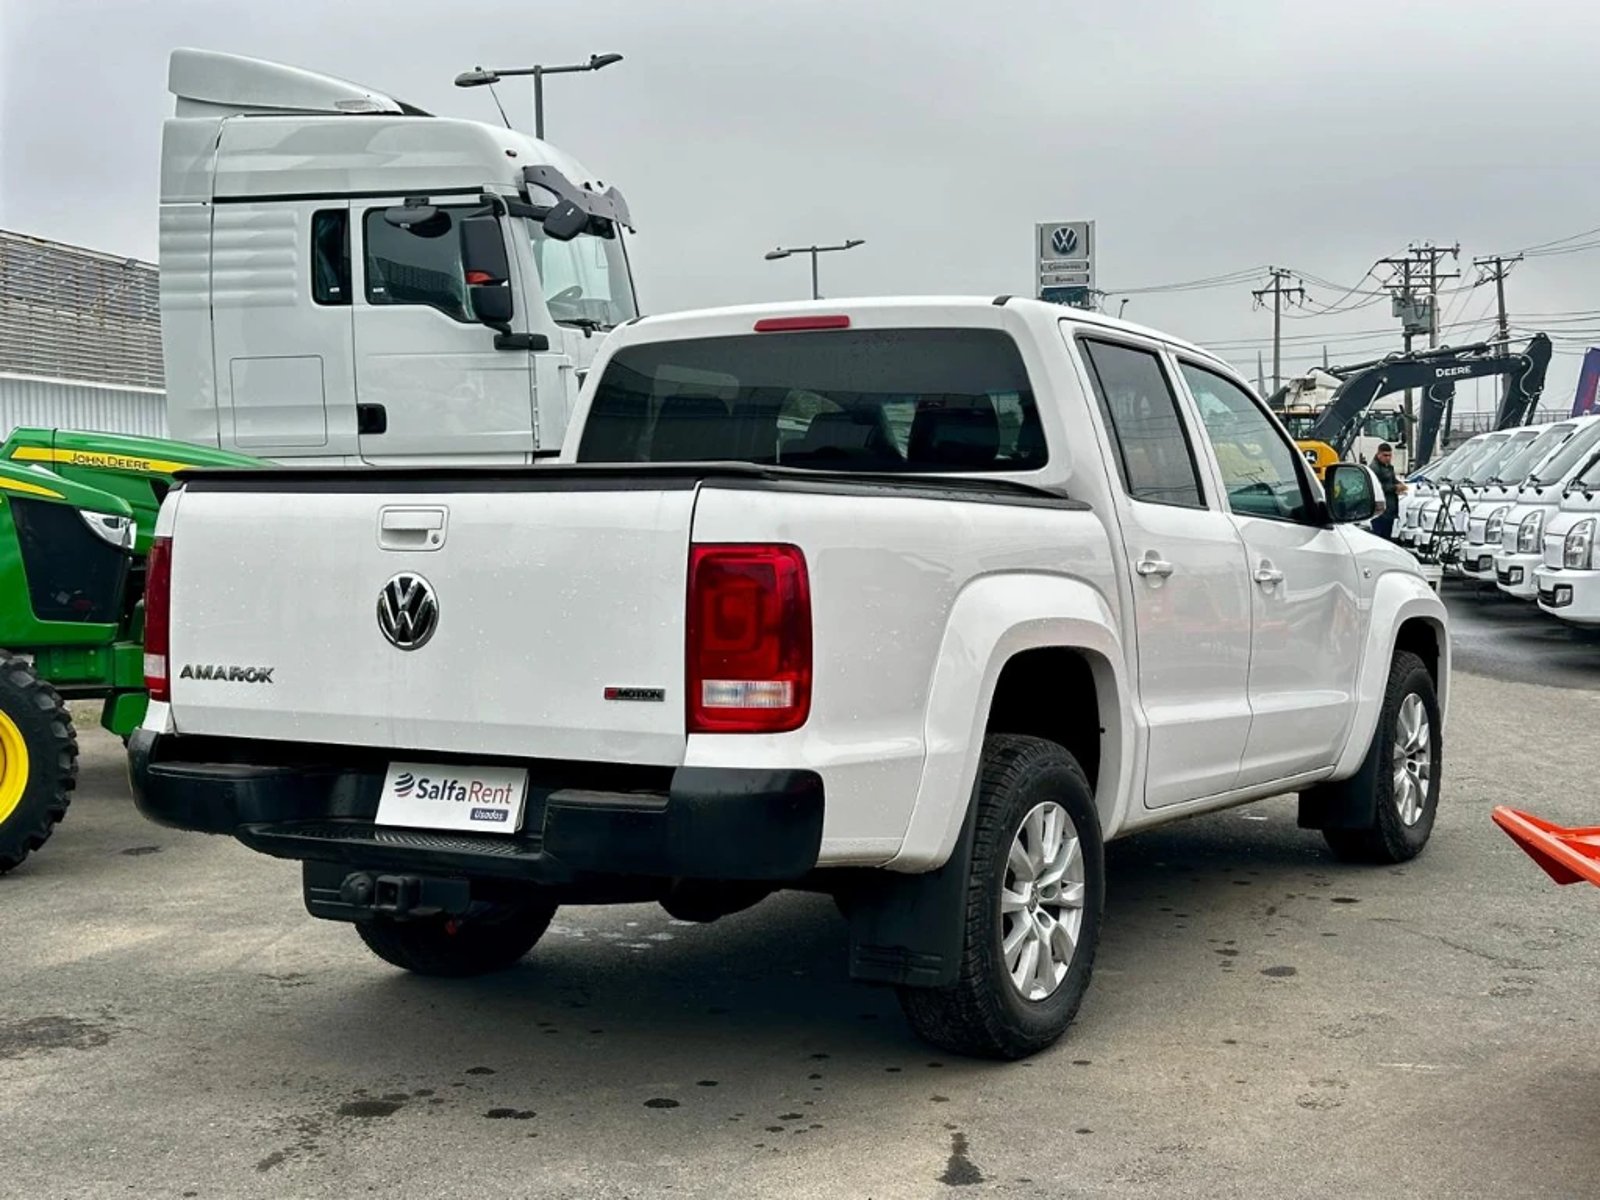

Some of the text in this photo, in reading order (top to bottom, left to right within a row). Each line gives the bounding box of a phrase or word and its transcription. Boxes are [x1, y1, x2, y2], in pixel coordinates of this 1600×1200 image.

[1436, 365, 1471, 377] DEERE
[71, 452, 150, 469] JOHN DEERE
[377, 571, 439, 651] VW
[179, 664, 274, 683] AMAROK
[474, 810, 504, 819] Usados
